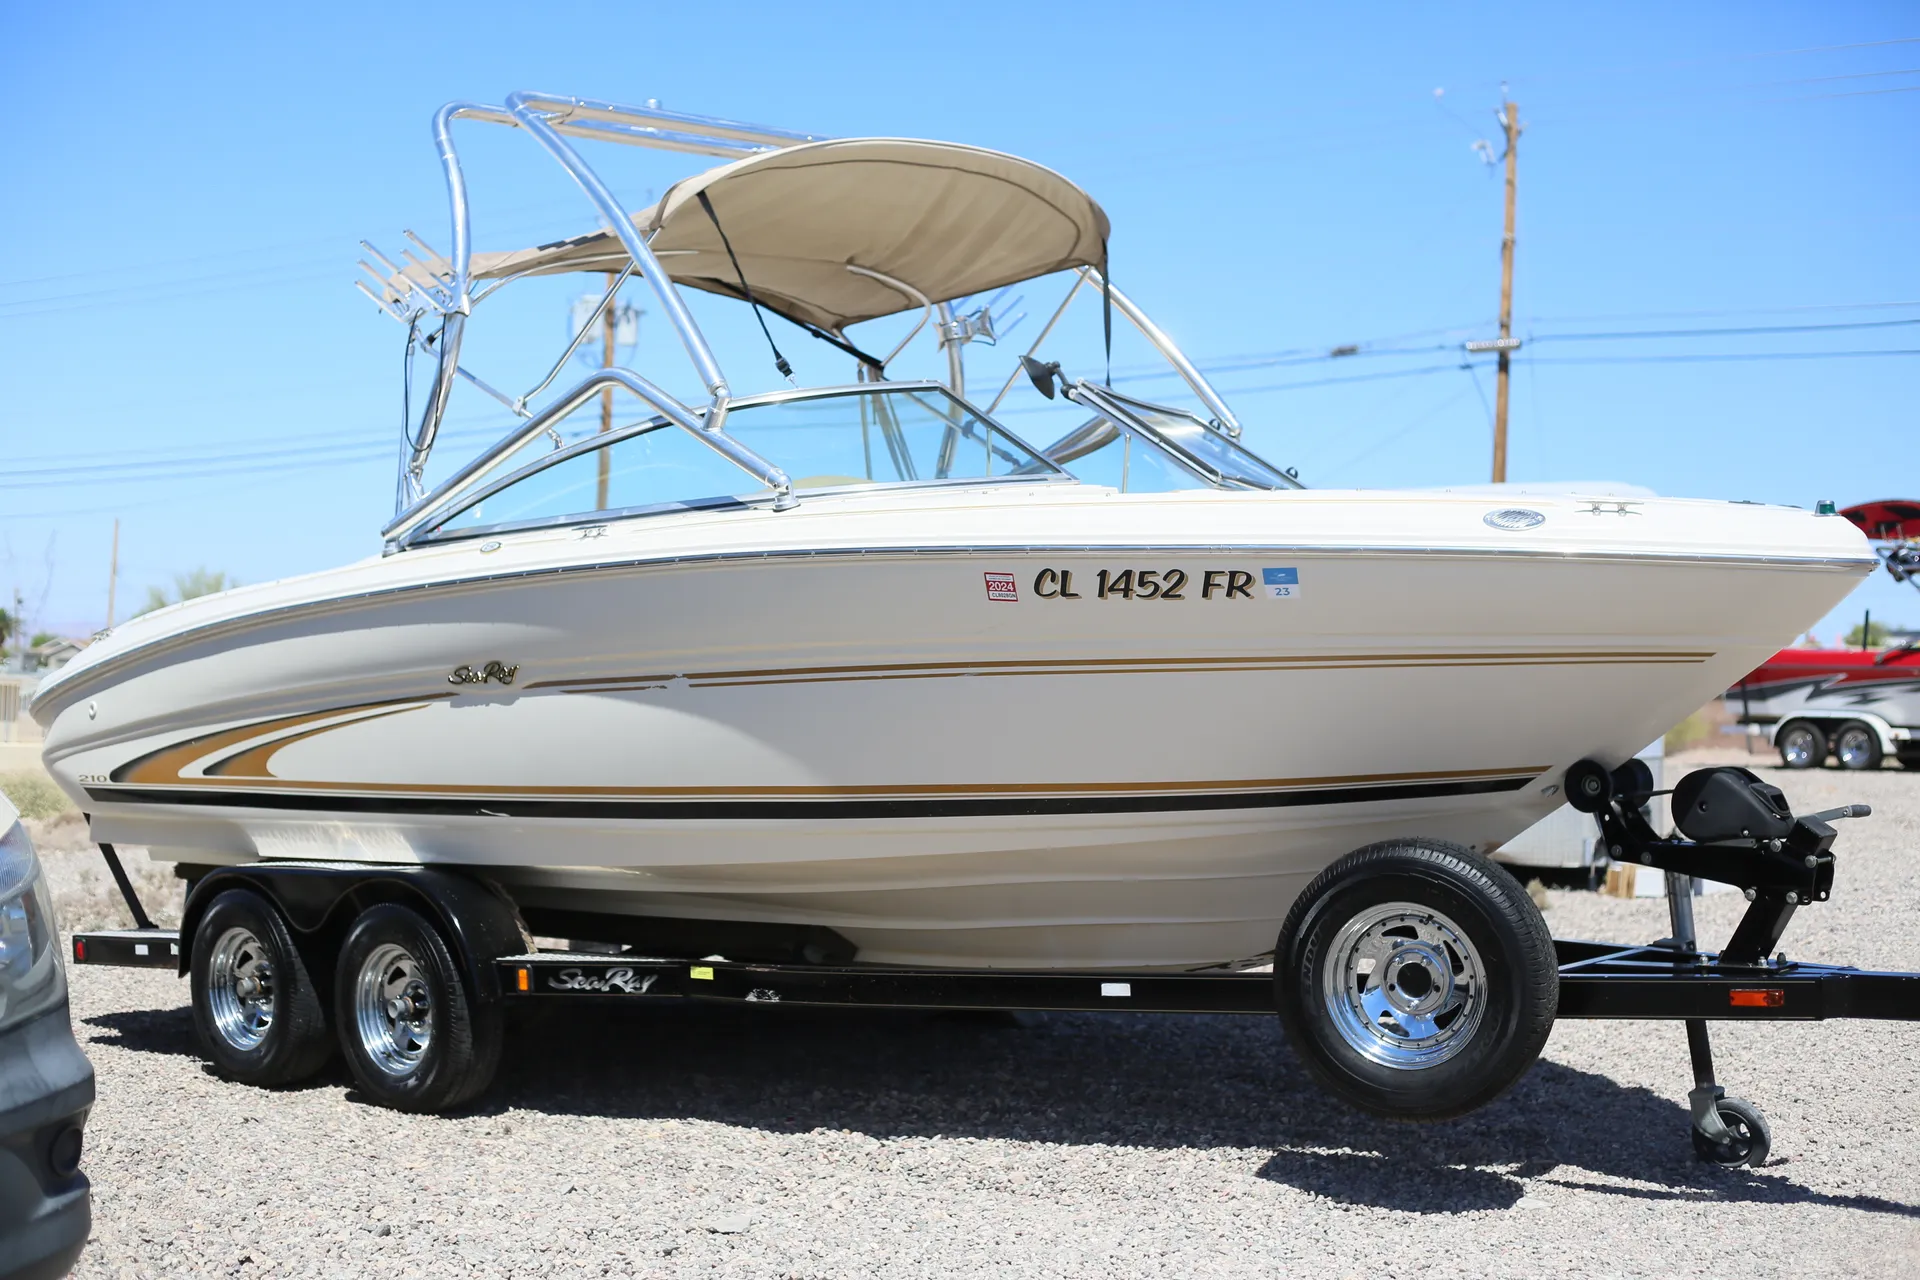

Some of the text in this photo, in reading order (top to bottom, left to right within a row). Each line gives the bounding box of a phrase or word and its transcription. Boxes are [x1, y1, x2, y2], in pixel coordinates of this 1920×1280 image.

[988, 581, 1014, 591] 2024
[1033, 567, 1256, 600] CL 1452 FR
[1274, 587, 1290, 596] 23
[79, 774, 107, 783] 210
